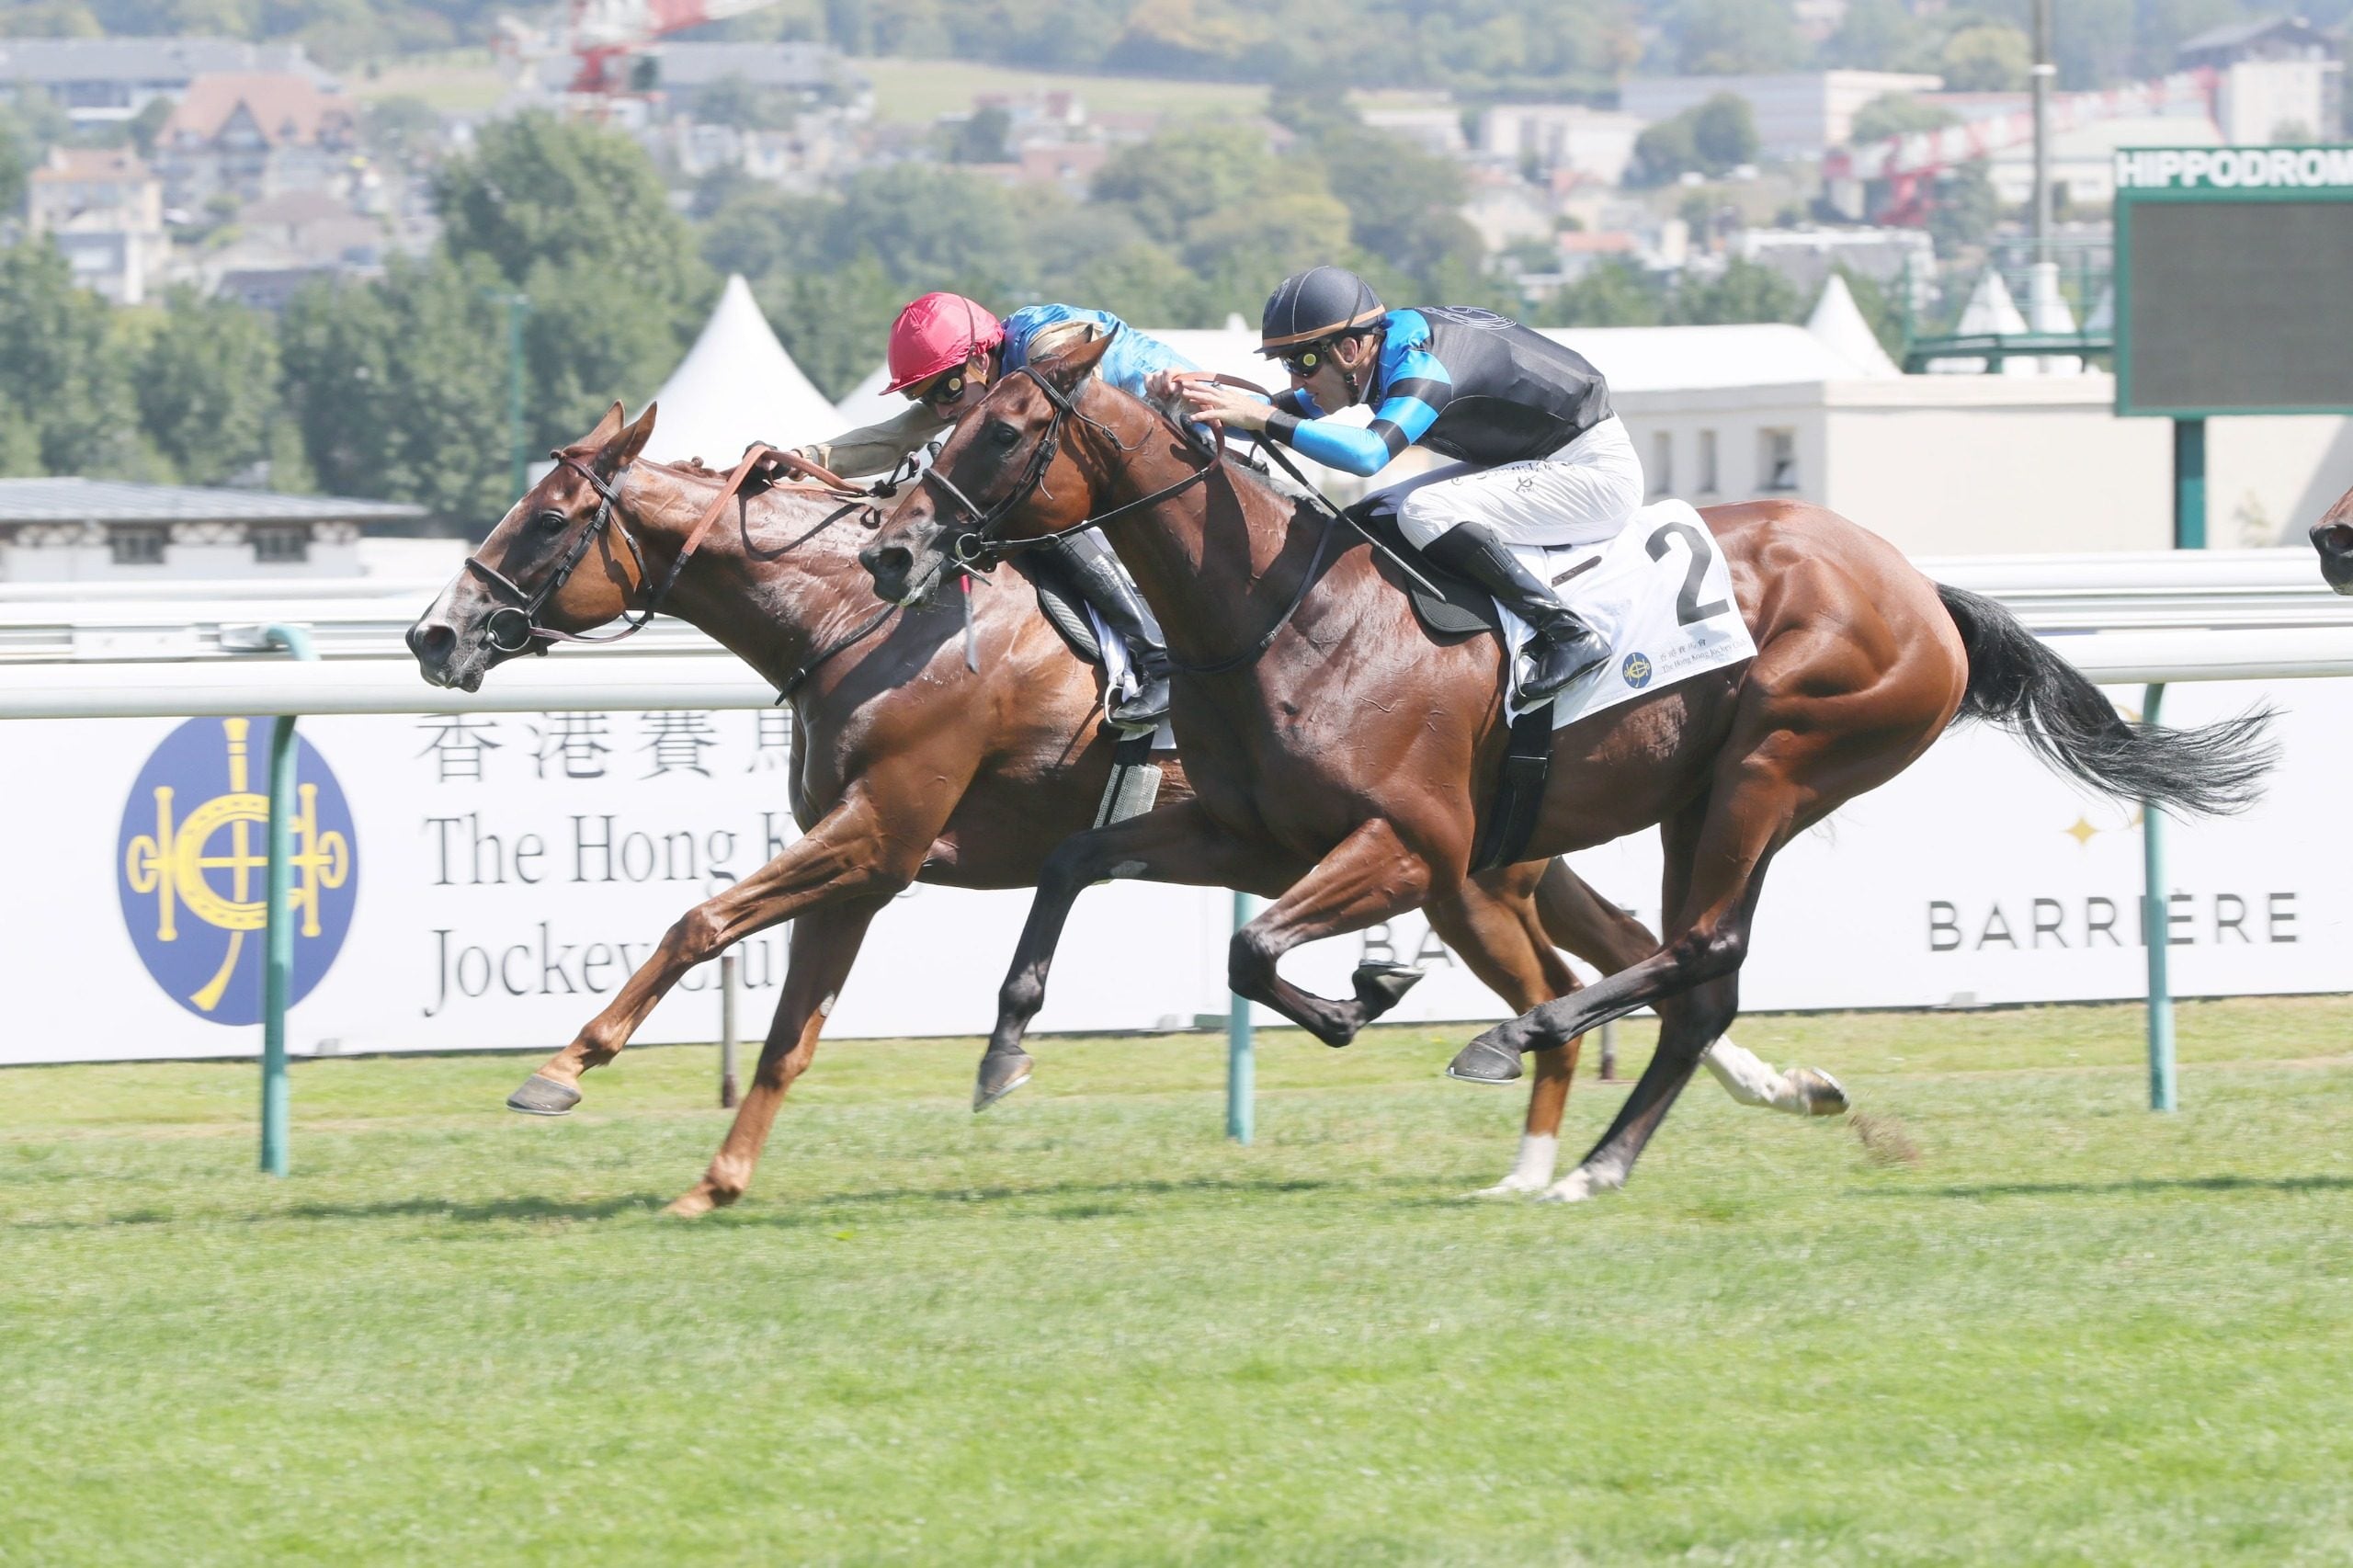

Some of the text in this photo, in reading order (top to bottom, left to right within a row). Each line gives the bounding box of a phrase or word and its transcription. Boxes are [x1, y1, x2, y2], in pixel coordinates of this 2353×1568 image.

[2117, 150, 2353, 187] HIPPODROM
[1644, 521, 1730, 627] 2
[424, 812, 547, 886] The
[569, 814, 738, 898] Hong
